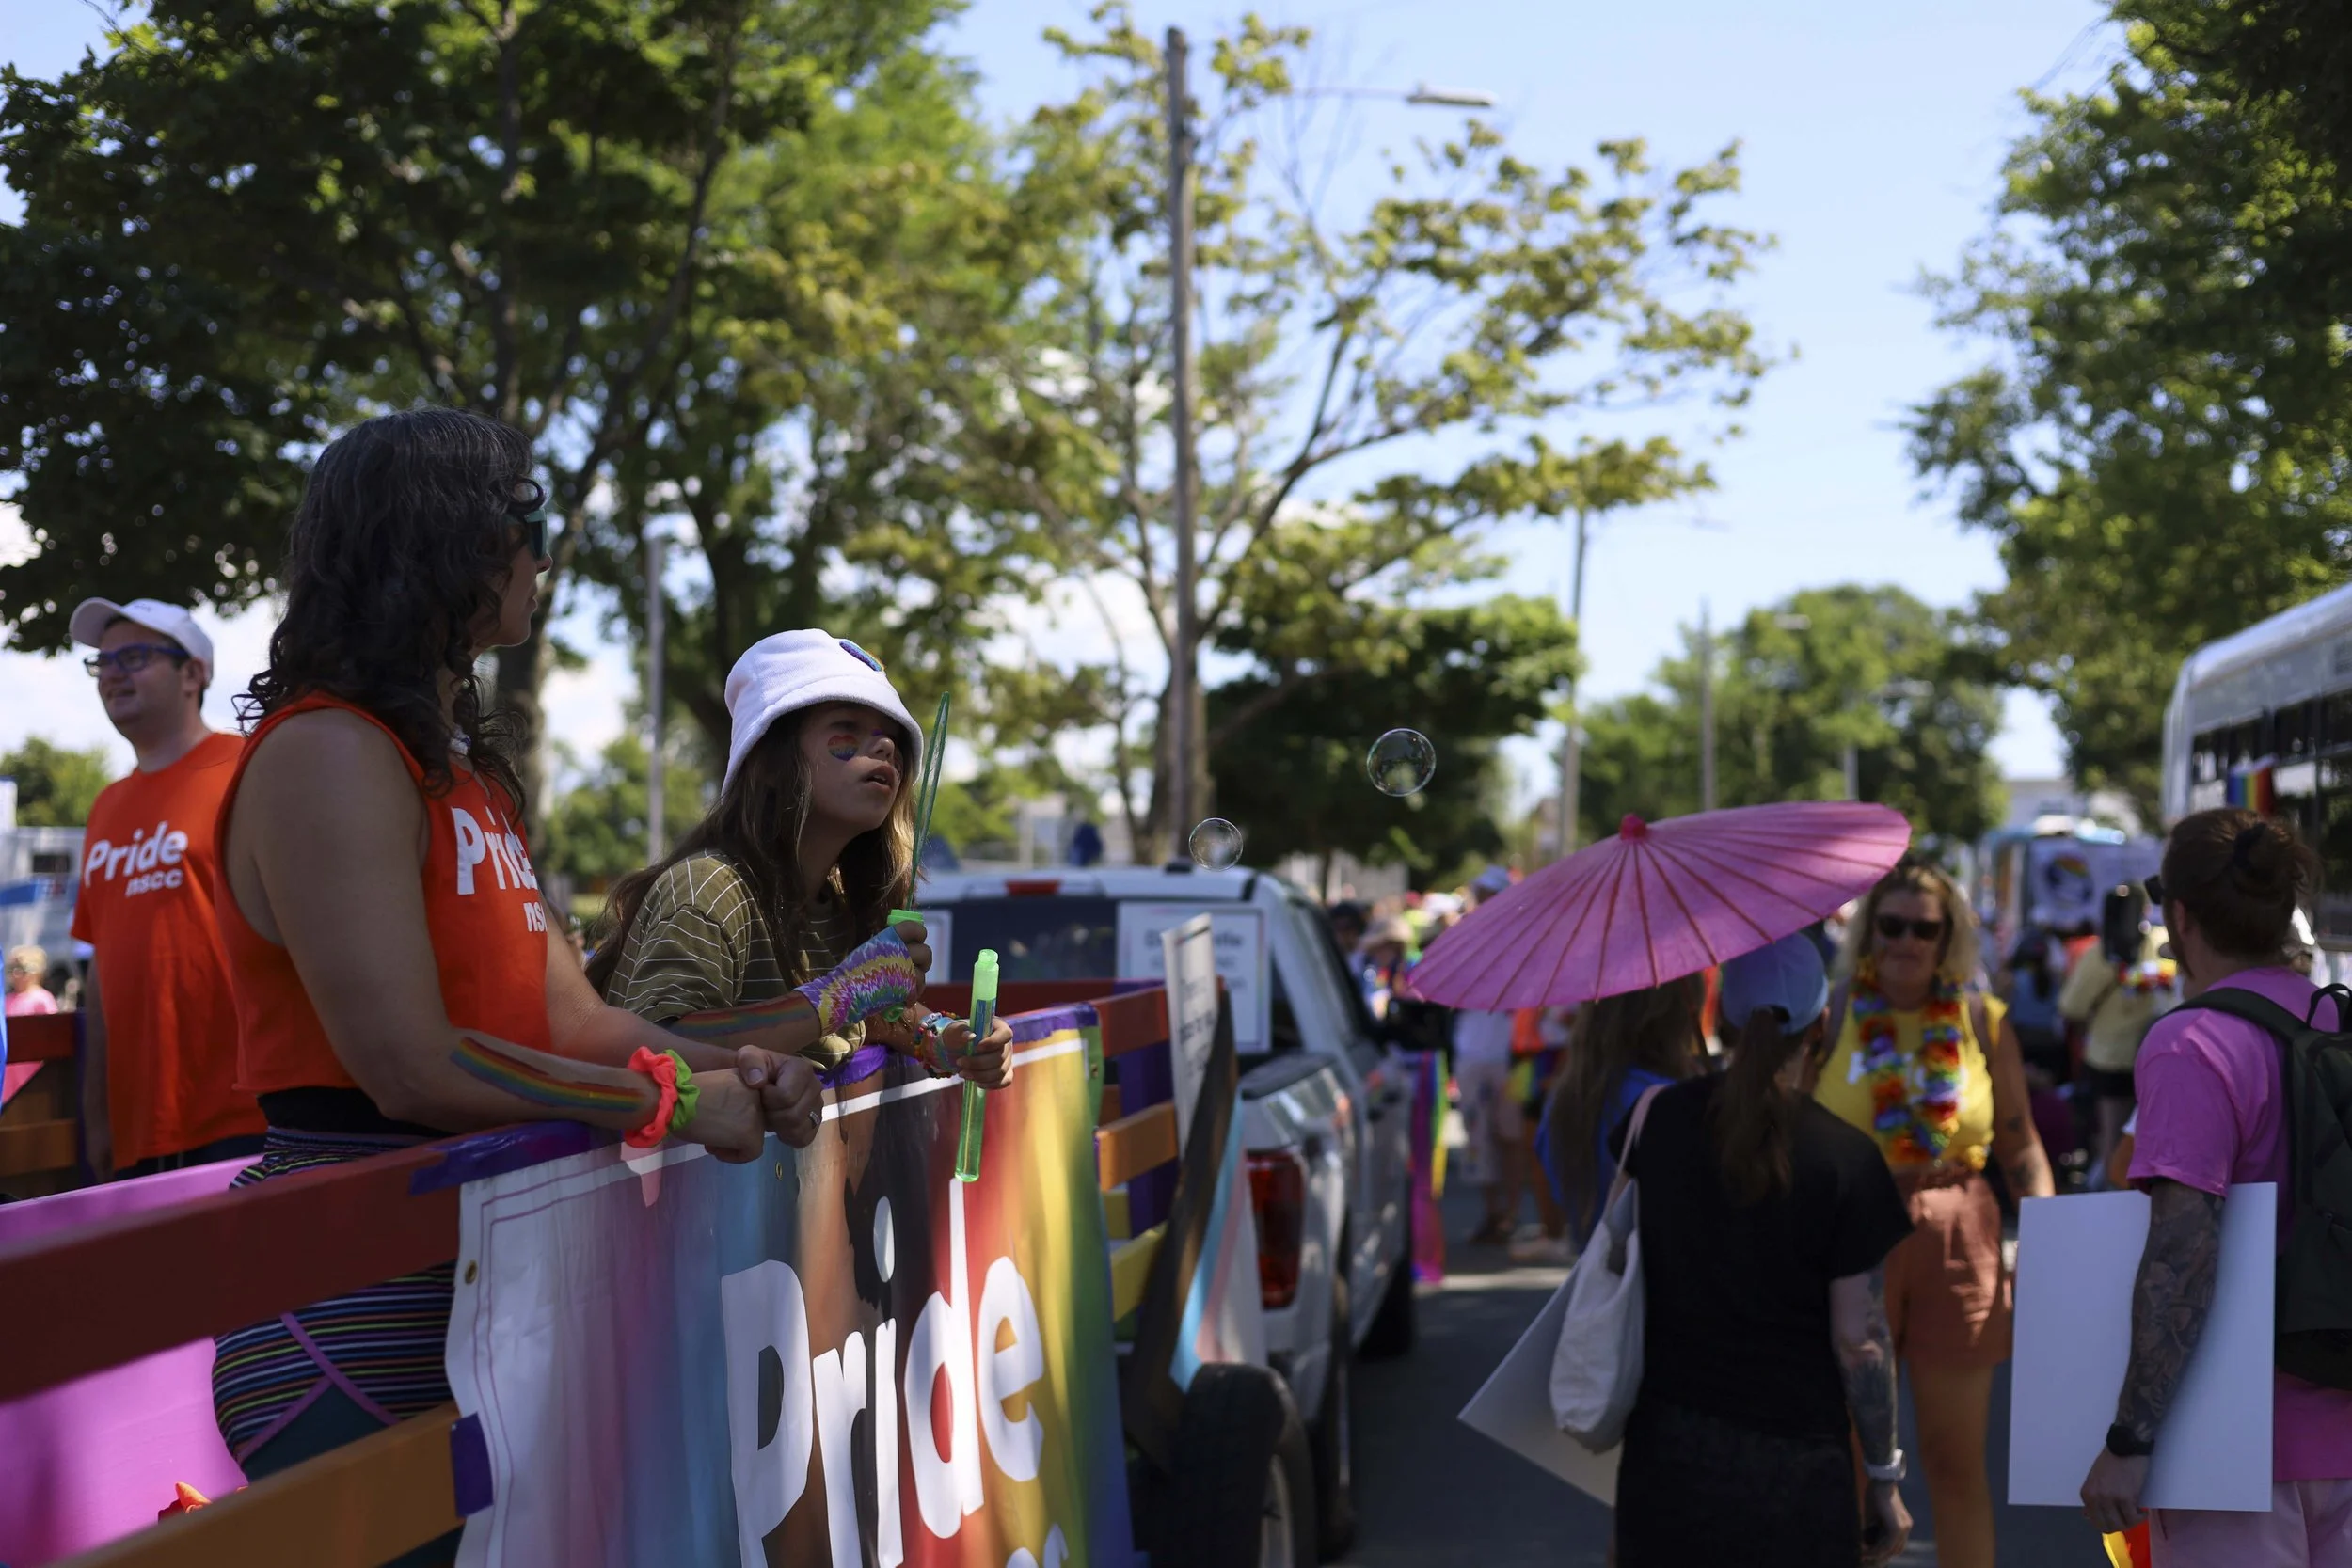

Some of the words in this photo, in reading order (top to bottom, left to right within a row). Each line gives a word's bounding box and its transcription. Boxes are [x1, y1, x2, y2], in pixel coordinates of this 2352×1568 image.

[84, 820, 188, 888] Pride
[125, 868, 183, 897] nscc
[523, 901, 548, 932] ns
[721, 1177, 1045, 1568] Pride
